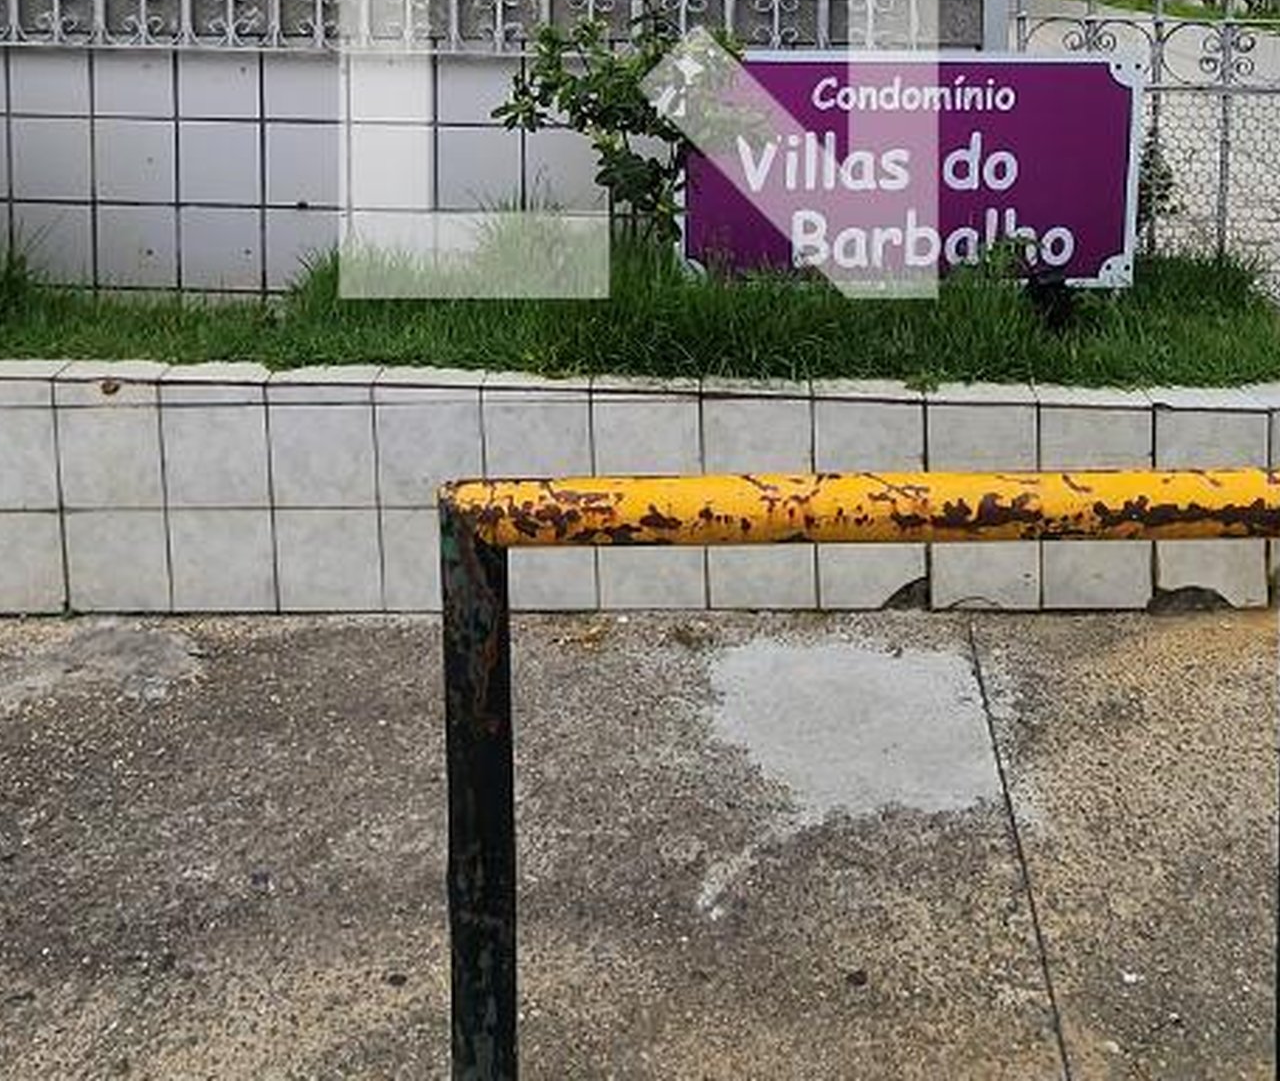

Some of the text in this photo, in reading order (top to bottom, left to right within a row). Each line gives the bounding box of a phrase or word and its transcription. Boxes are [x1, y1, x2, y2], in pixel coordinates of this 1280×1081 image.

[811, 75, 1016, 111] Condomínio
[736, 131, 1019, 192] Villas do
